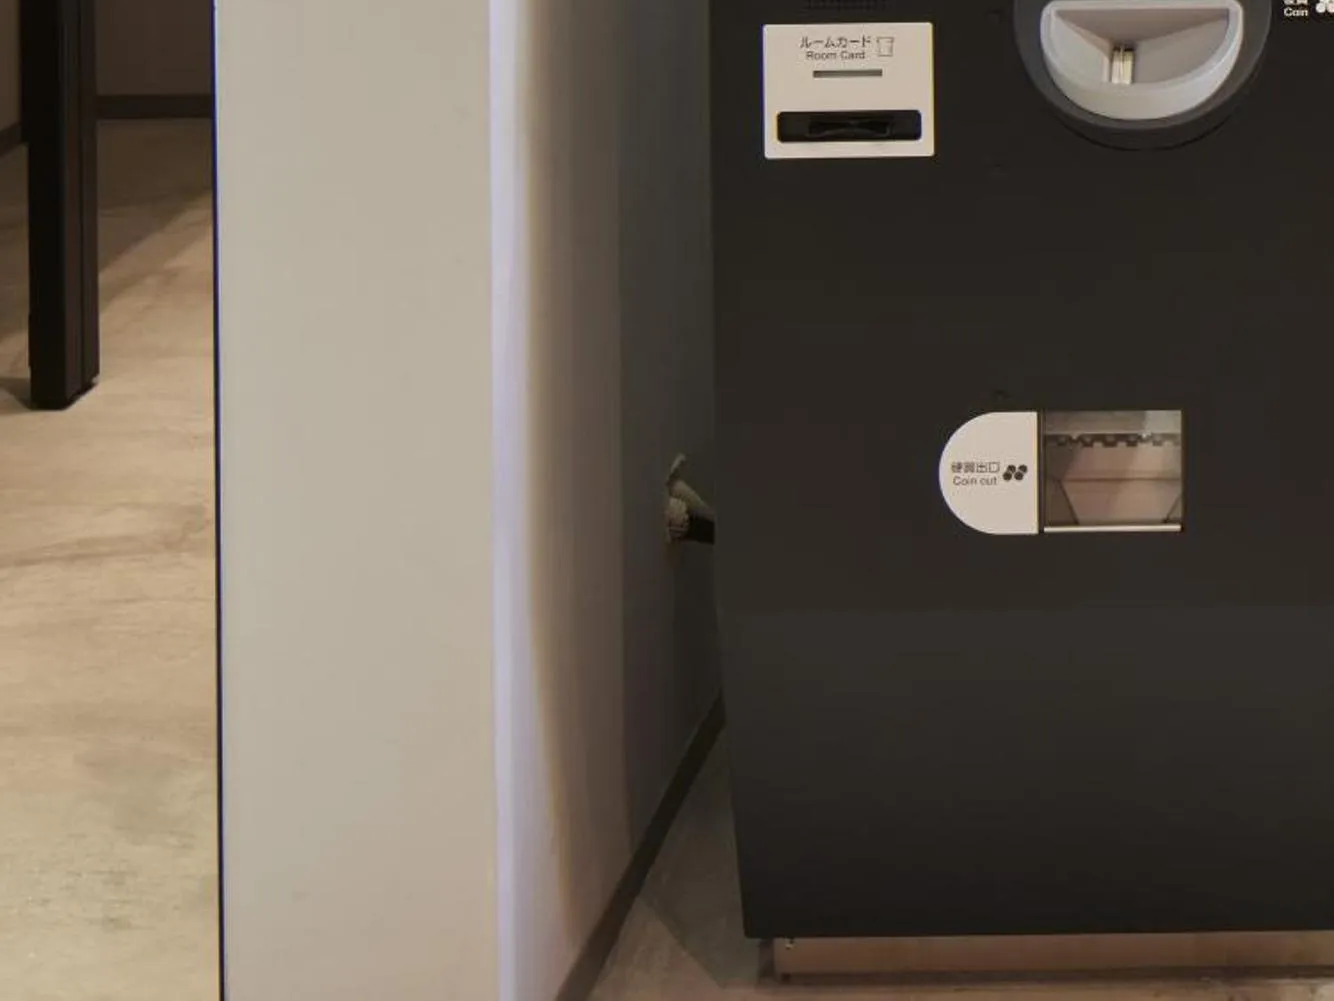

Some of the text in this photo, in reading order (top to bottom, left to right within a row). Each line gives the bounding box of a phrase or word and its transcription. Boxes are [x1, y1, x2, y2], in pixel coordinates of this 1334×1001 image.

[1283, 6, 1309, 17] Coin
[800, 35, 871, 49] ルームカード
[806, 50, 866, 60] Room Card
[952, 475, 977, 486] Coin
